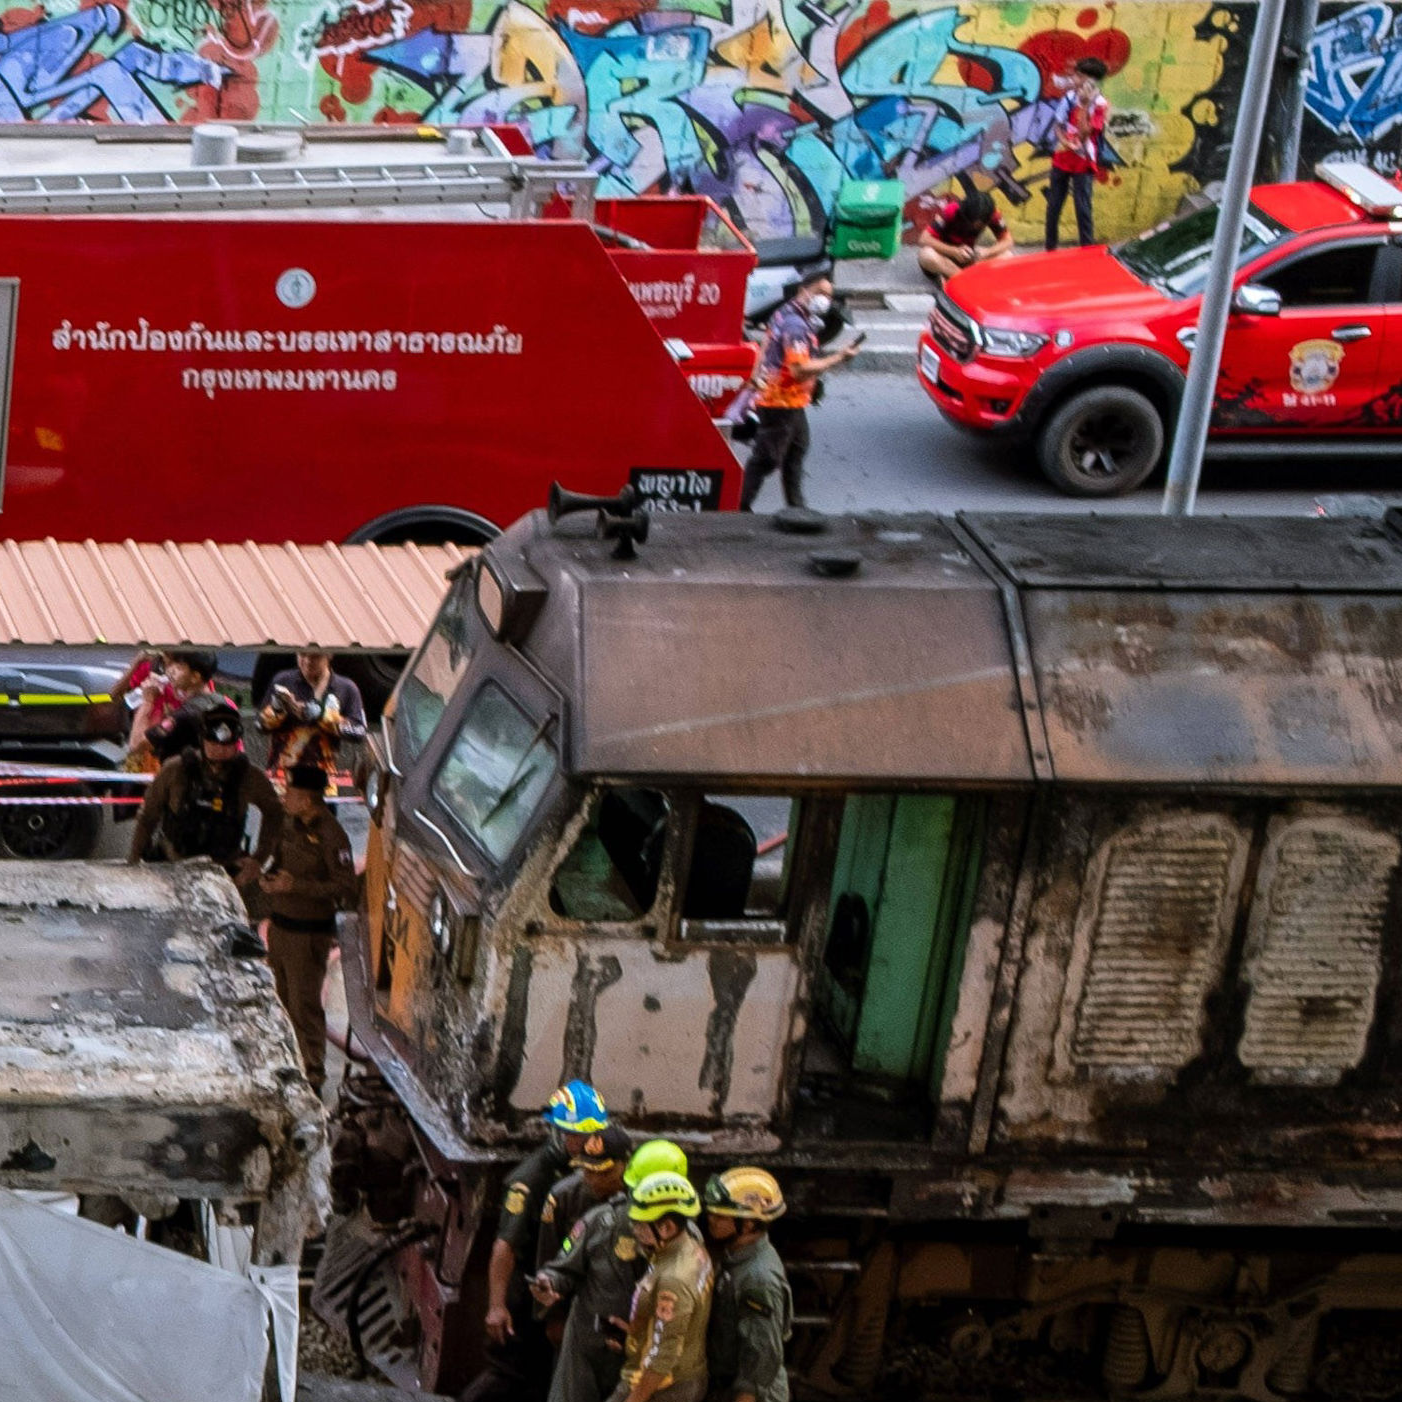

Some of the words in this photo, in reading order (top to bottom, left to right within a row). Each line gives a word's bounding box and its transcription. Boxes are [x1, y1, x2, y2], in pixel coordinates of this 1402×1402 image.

[847, 240, 881, 253] Grab
[697, 281, 720, 305] 20
[52, 318, 523, 354] สำนักป้องกันและบรรเทาสาธารณภัย
[182, 366, 397, 399] กรุงเทพมหานคร
